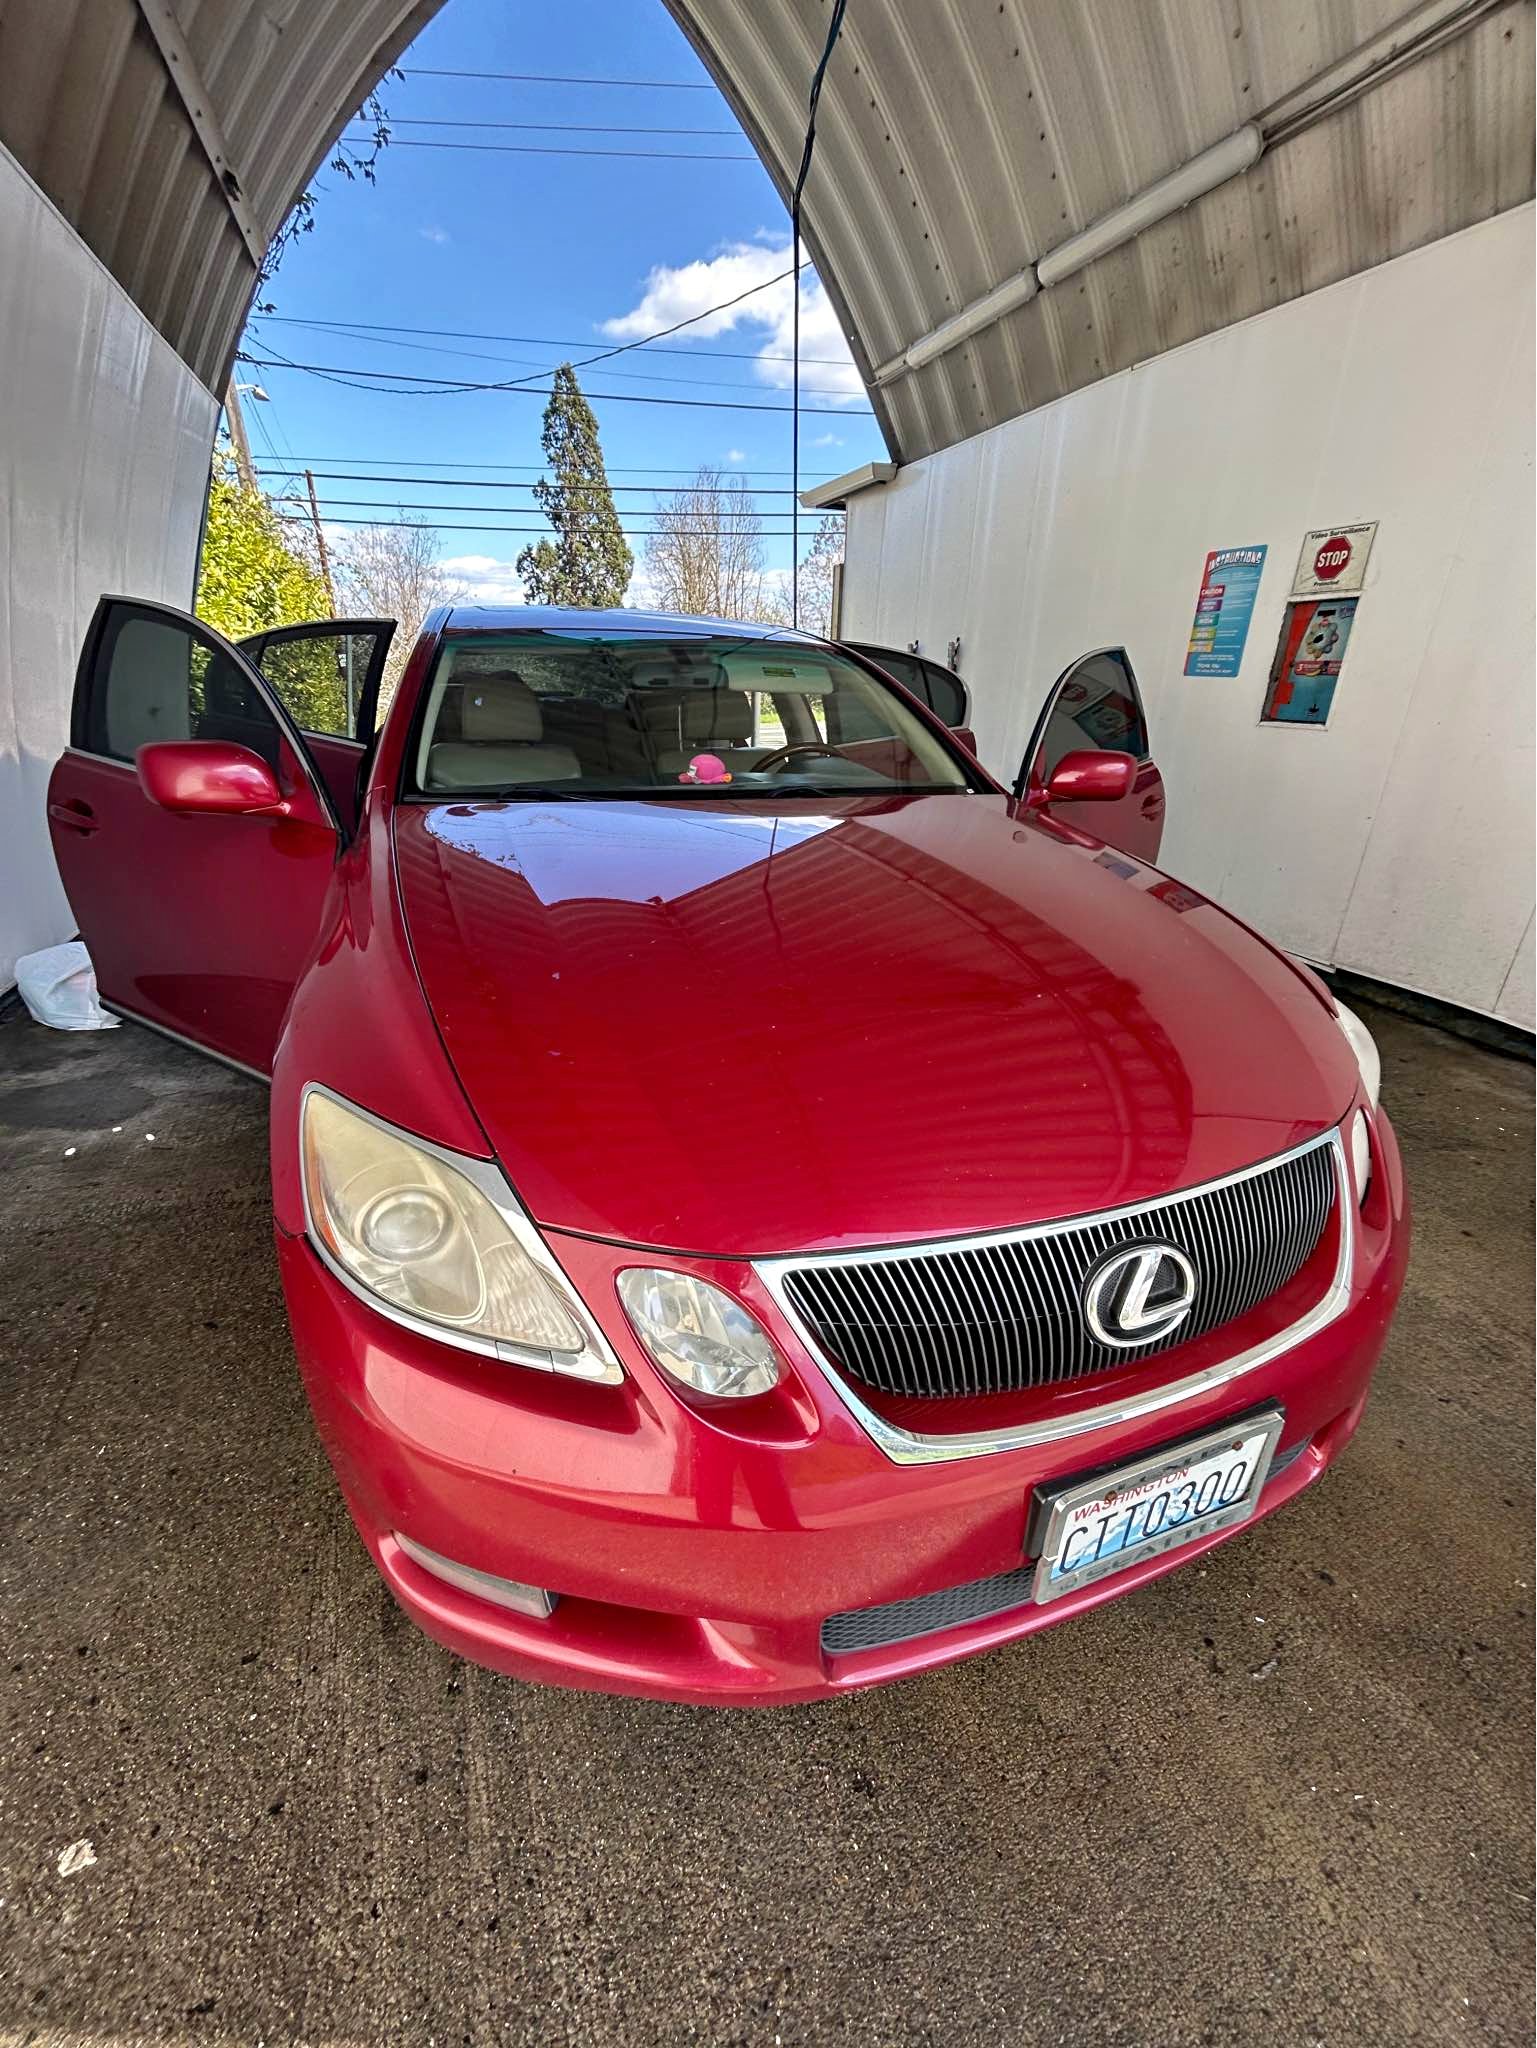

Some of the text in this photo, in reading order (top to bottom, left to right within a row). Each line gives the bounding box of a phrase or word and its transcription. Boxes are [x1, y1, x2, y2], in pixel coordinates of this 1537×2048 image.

[1208, 551, 1262, 571] INSTRUCTIONS
[1317, 550, 1349, 568] STOP
[1074, 1468, 1190, 1522] WASHINGTON
